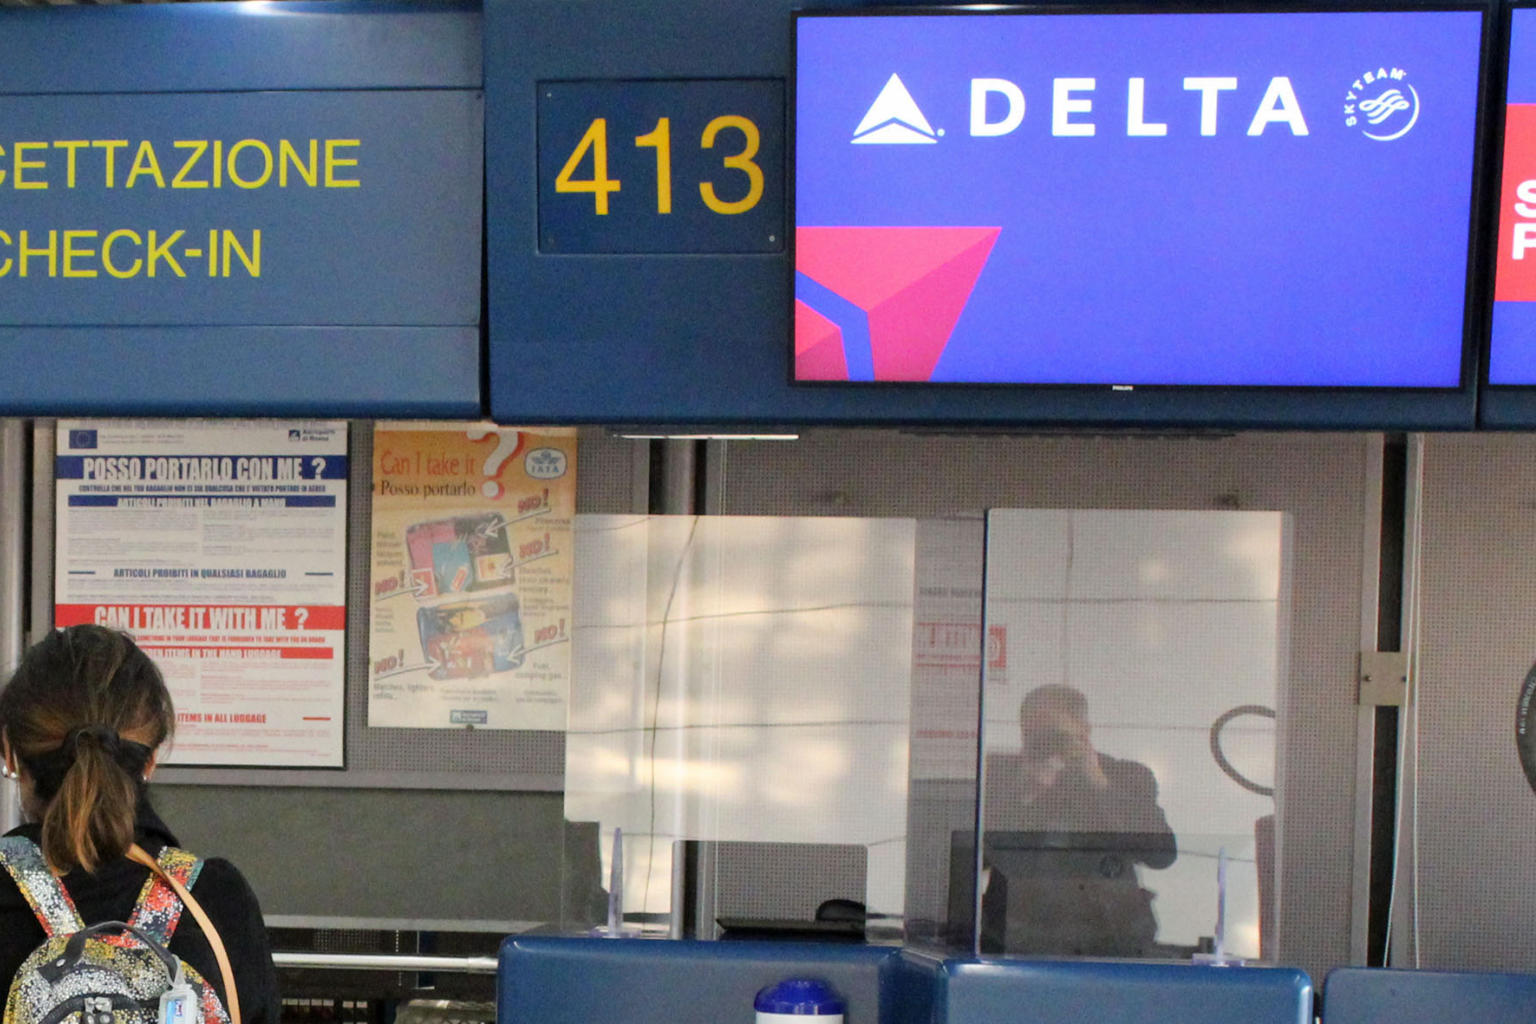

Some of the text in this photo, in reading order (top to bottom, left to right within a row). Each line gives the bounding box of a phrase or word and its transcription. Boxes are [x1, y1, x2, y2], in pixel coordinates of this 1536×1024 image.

[970, 76, 1310, 137] DELTA
[1344, 67, 1405, 127] SKYTEAM
[554, 114, 765, 216] 413
[83, 457, 326, 480] POSSO PORTARLO CON ME ?
[381, 451, 410, 475] Can
[427, 452, 460, 475] take
[465, 452, 475, 475] it
[531, 465, 559, 473] IATA
[381, 480, 476, 499] Posso portarlo
[114, 568, 286, 579] ARTICOLI PROIBITI IN QUALSIASI BAGAGLIO
[94, 606, 308, 630] CAN I TAKE IT WITH ME ?
[177, 714, 266, 724] ITEMS IN ALL LUGGAGE
